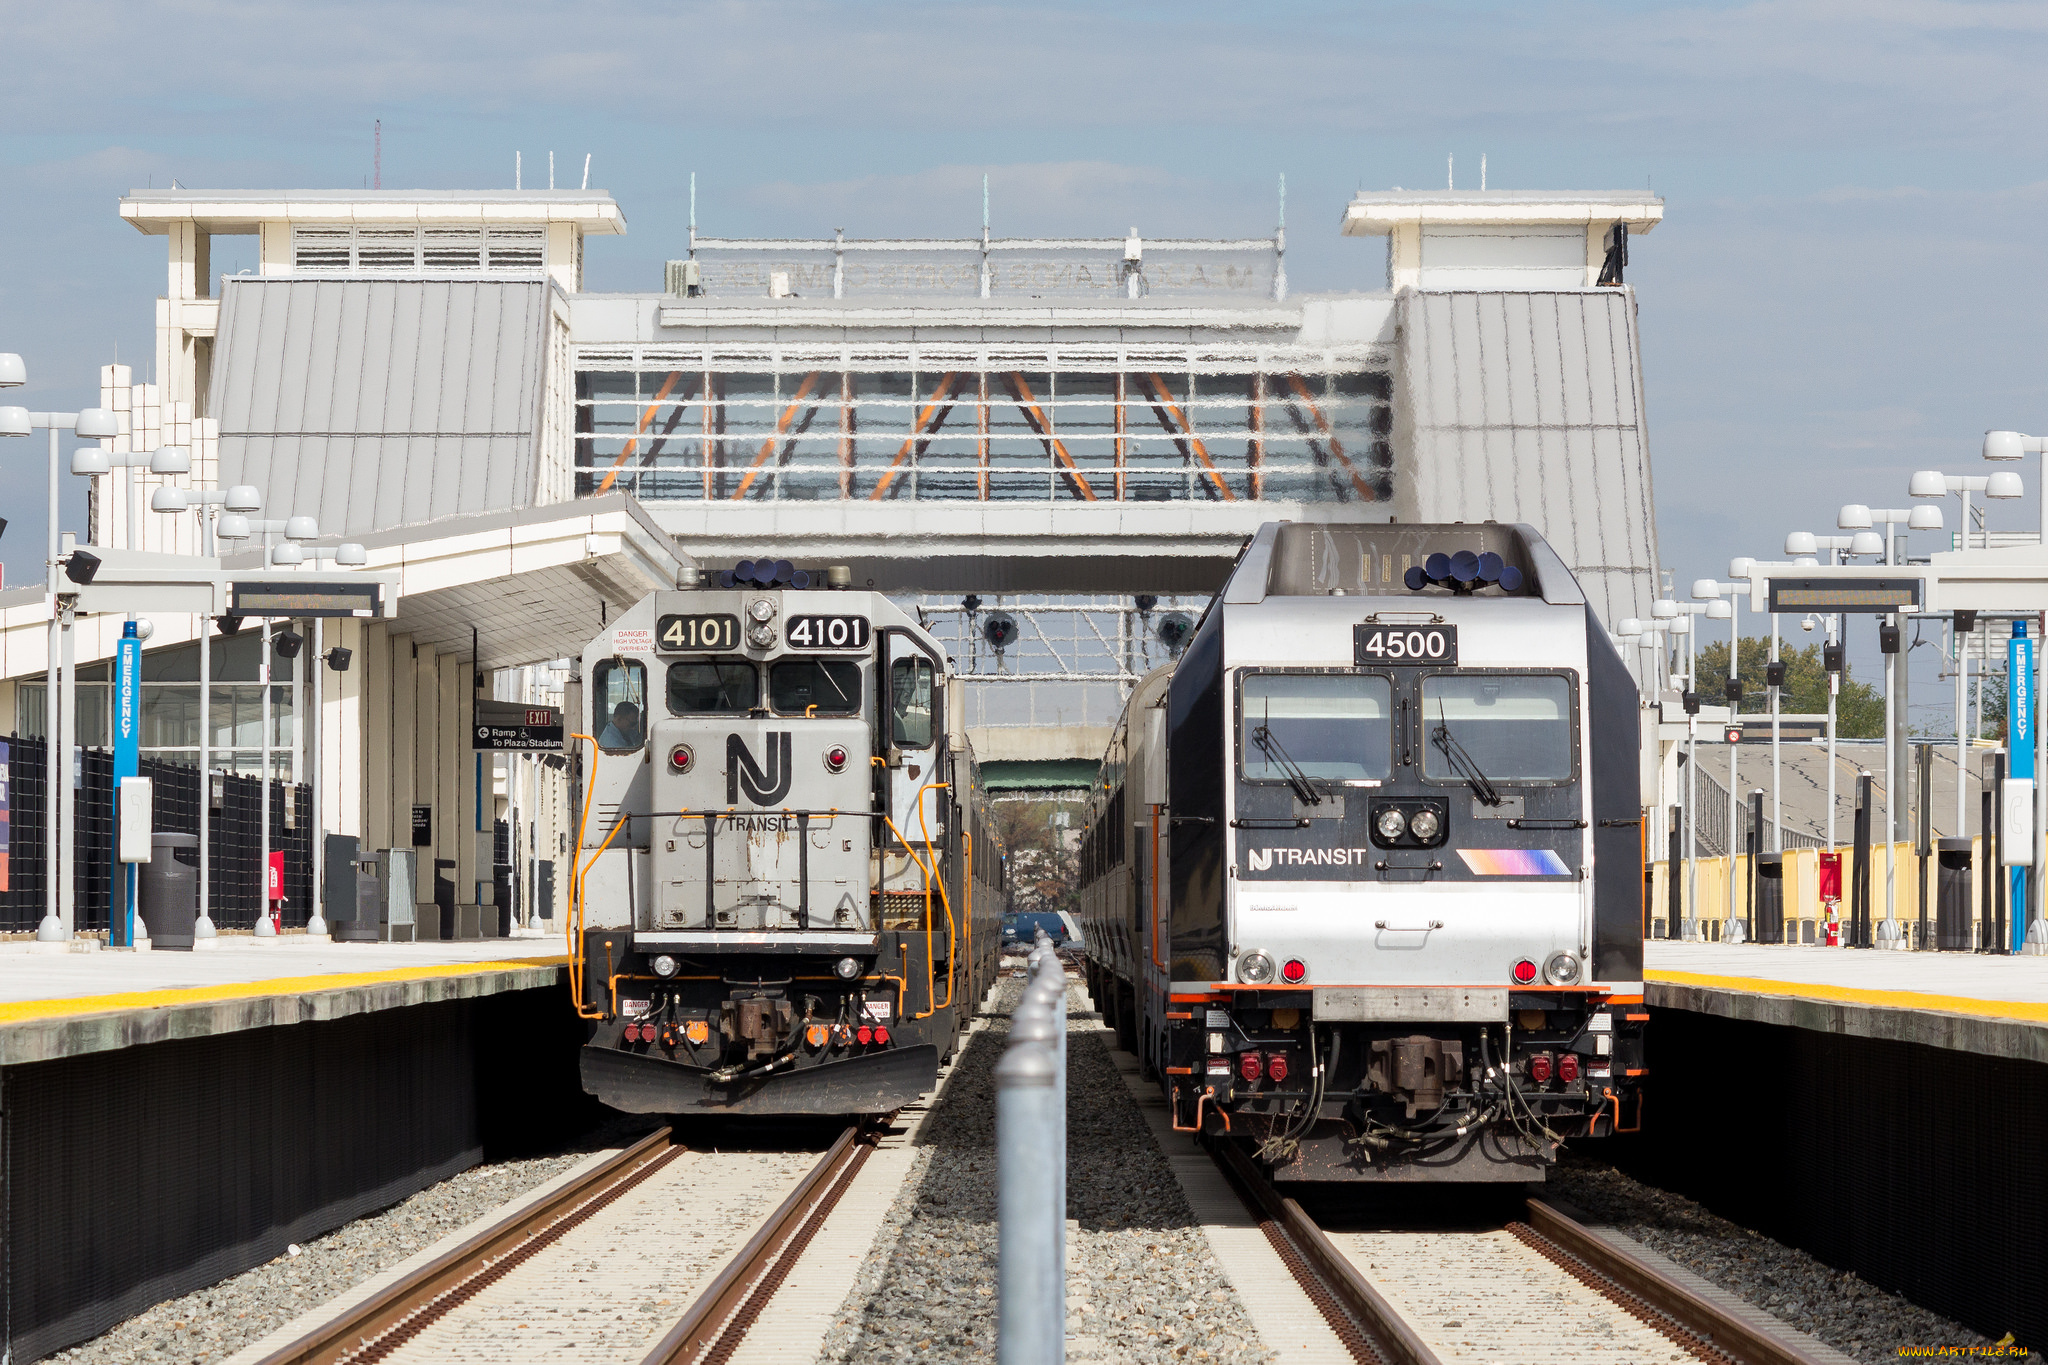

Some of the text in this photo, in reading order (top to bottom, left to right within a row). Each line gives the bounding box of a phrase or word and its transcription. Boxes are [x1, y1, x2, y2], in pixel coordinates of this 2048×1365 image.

[663, 619, 731, 646] 4101
[790, 619, 860, 645] 4101
[1366, 631, 1445, 658] 4500
[121, 644, 133, 738] EMERGENCY
[2016, 644, 2027, 740] EMERGENCY
[529, 711, 548, 724] EXIT
[492, 729, 516, 738] Ramp
[503, 739, 563, 748] Plaza/Stadium
[726, 732, 791, 806] NJ
[726, 817, 791, 832] TRANSIT
[1248, 848, 1366, 871] NJ TRANSIT
